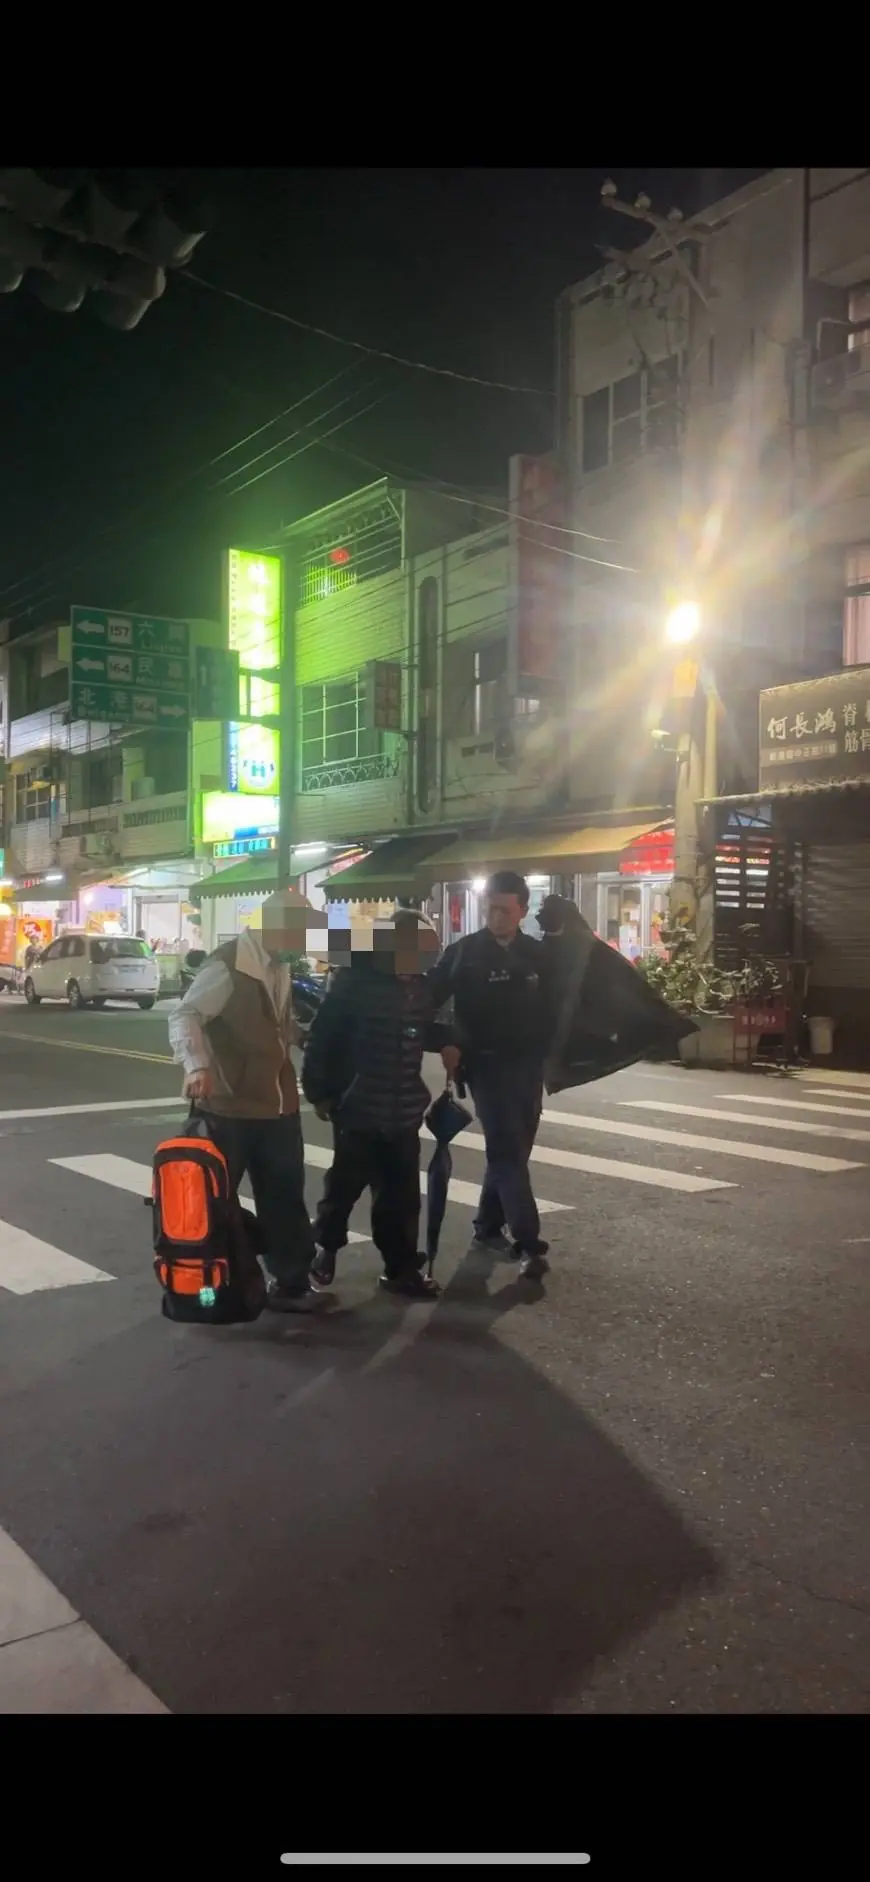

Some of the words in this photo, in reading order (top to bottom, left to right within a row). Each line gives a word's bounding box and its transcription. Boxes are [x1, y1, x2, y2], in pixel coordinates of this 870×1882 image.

[110, 625, 130, 638] 157
[110, 663, 130, 675] 164
[842, 699, 870, 726] 脊
[767, 708, 837, 739] 何長鴻
